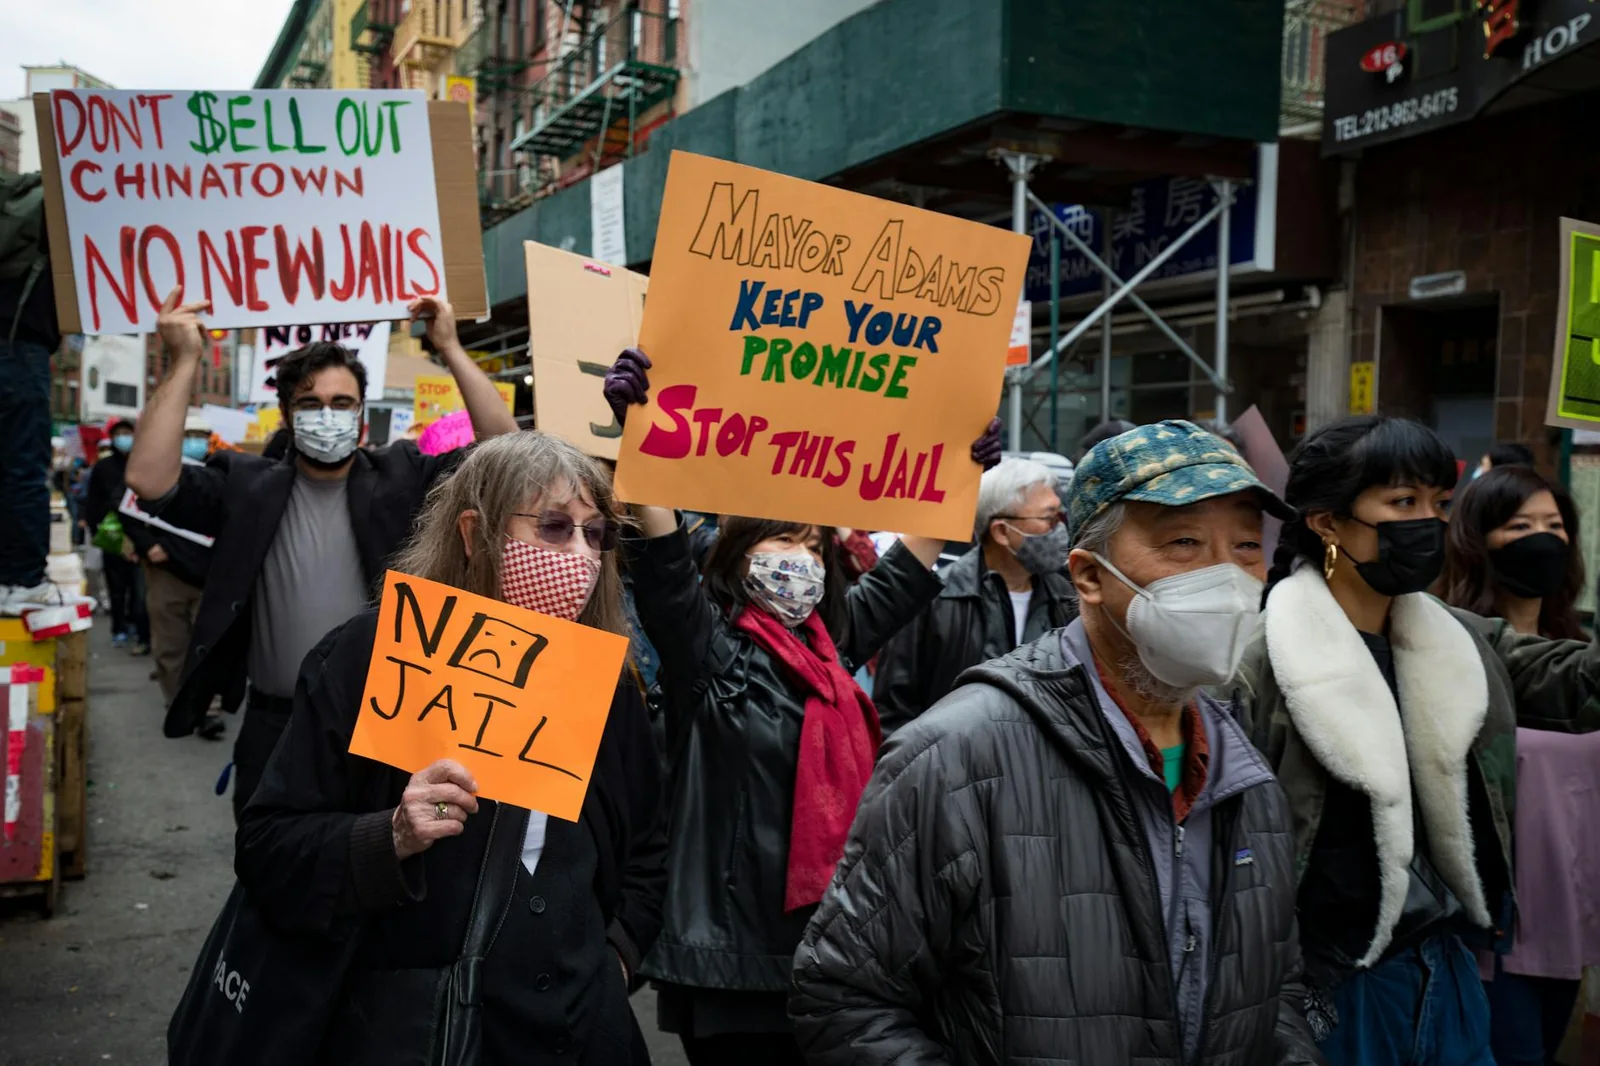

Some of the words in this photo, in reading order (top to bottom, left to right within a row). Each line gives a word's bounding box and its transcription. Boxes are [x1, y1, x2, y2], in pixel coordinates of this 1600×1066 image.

[53, 89, 174, 158] DON'T
[187, 90, 327, 156] $ELL
[335, 96, 412, 158] OUT
[70, 159, 365, 203] CHINATOWN
[84, 224, 186, 332] NO
[197, 224, 325, 317] NEW
[329, 219, 441, 303] JAILS
[689, 181, 851, 276] MAYOR
[851, 219, 1005, 316] ADAMS
[264, 325, 312, 349] NO
[322, 323, 374, 341] NEW
[729, 279, 824, 331] KEEP
[844, 300, 943, 354] YOUR
[418, 383, 451, 395] STOP
[740, 335, 918, 400] PROMISE
[638, 384, 769, 459] STOP
[768, 430, 857, 488] THIS
[858, 432, 946, 504] JAIL
[370, 656, 583, 781] JAIL
